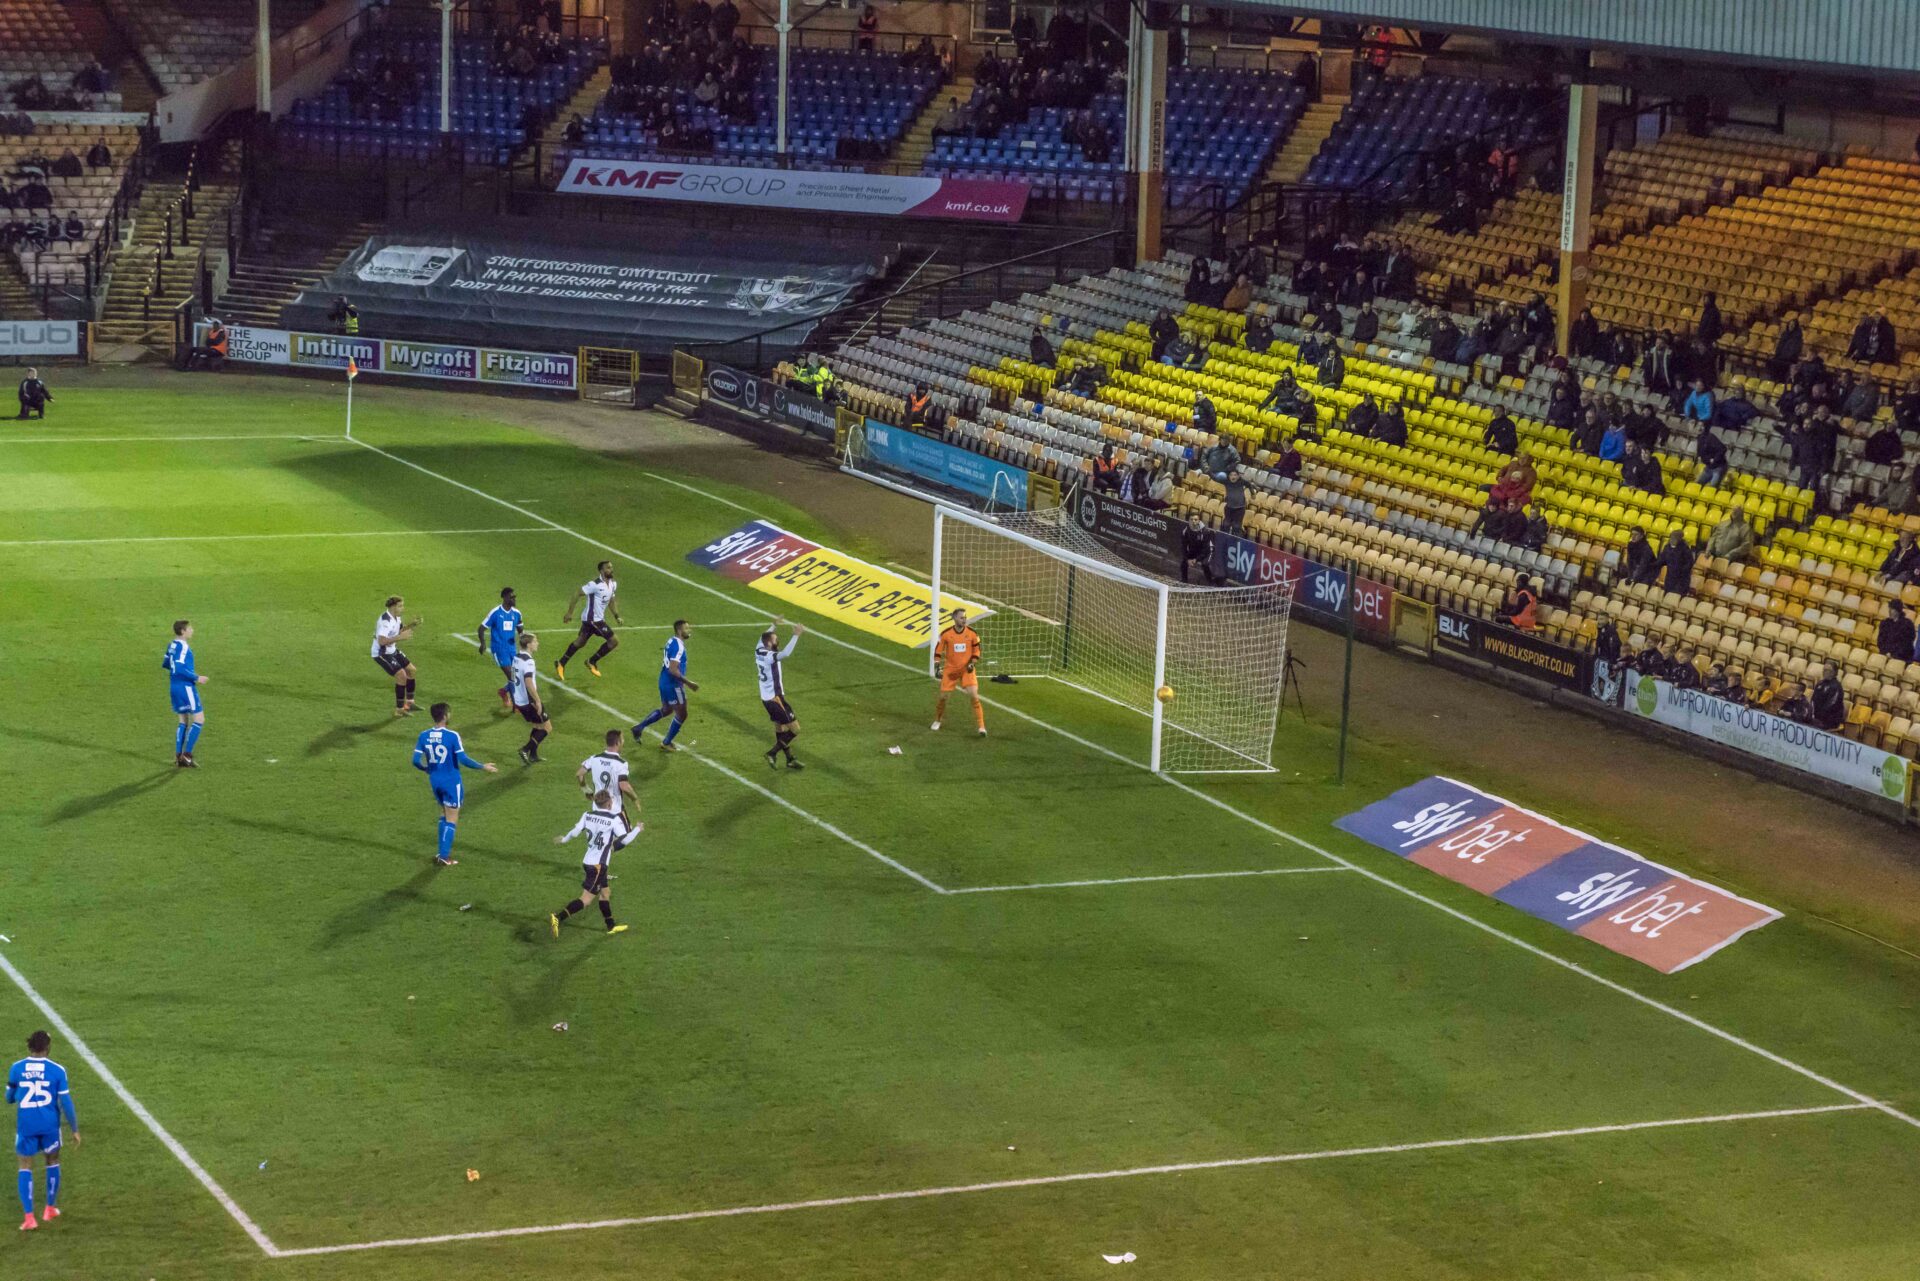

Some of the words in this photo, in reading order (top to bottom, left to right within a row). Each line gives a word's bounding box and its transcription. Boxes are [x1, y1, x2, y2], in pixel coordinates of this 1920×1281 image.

[680, 174, 786, 196] GROUP
[945, 200, 1010, 214] kmf.co.uk
[1563, 161, 1575, 251] REFRESHMENT
[450, 279, 496, 291] PORT
[482, 267, 501, 279] IN
[503, 270, 617, 289] PARTNERSHIP
[618, 280, 663, 292] WITH
[664, 284, 698, 295] THE
[226, 327, 251, 339] THE
[226, 348, 272, 361] GROUP
[227, 338, 287, 353] FITZJOHN
[298, 336, 373, 359] Intium
[391, 345, 472, 368] Mycroft
[358, 360, 373, 368] Ltd
[420, 366, 471, 378] Interiors
[487, 353, 569, 375] Fitzjohn
[534, 377, 569, 387] Flooring
[713, 378, 737, 394] HOLDCROFT
[788, 402, 835, 430] www.holdcroft.com
[1102, 501, 1131, 519] DANIEL'S
[1132, 511, 1168, 531] DELIGHTS
[1111, 518, 1125, 528] FAMILY
[704, 529, 763, 565] sky
[737, 538, 803, 573] bet
[1227, 541, 1256, 581] sky
[1260, 550, 1291, 587] bet
[1315, 570, 1346, 612] sky
[857, 590, 954, 636] BETTER
[1439, 614, 1470, 641] BLK
[1484, 635, 1576, 678] WWW.BLKSPORT.CO.UK
[1668, 685, 1731, 723] IMPROVING
[1736, 707, 1767, 735] YOUR
[1771, 718, 1862, 765] PRODUCTIVITY
[425, 744, 448, 764] 19
[600, 771, 611, 790] 9
[1392, 799, 1475, 848] sky
[1438, 814, 1532, 864] bet
[1556, 868, 1646, 921] sky
[1608, 885, 1708, 938] bet
[19, 1080, 53, 1109] 25
